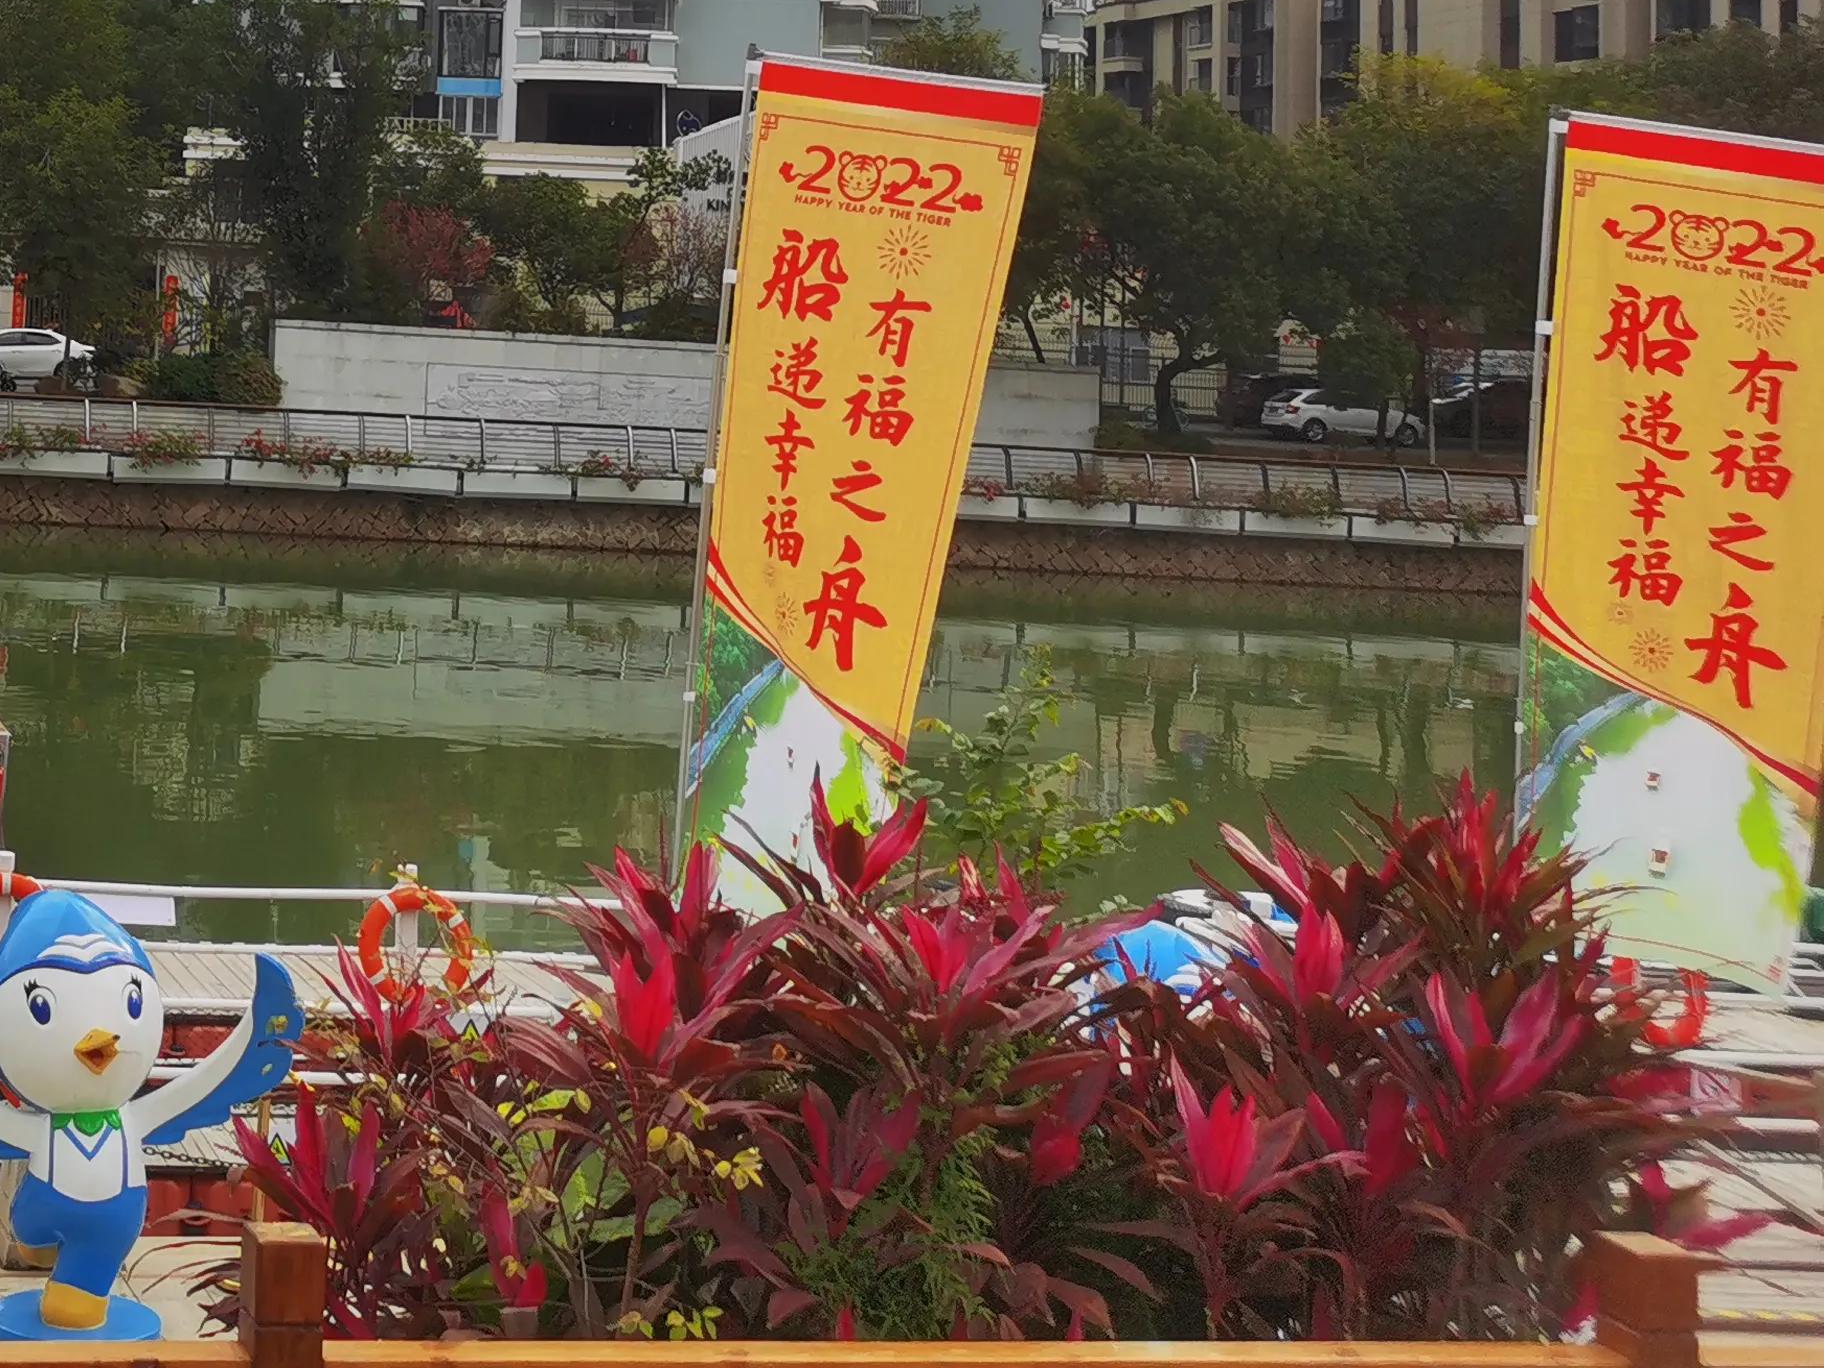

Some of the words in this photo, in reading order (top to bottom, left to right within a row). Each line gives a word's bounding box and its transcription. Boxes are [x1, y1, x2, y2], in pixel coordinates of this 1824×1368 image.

[794, 194, 833, 209] HAPPY
[838, 200, 866, 216] YEAR
[869, 205, 883, 217] OF
[889, 208, 912, 221] THE
[916, 212, 952, 228] TIGER
[796, 144, 962, 214] 2022
[1625, 251, 1668, 267] HAPPY
[1673, 259, 1708, 273] YEAR
[1714, 266, 1733, 277] OF
[1738, 269, 1764, 282] THE
[1770, 274, 1809, 290] TIGER
[1626, 203, 1816, 277] 2022
[757, 228, 849, 568] 船递幸福
[803, 288, 932, 672] 有福之舟
[1594, 283, 1699, 606] 船递幸福
[1684, 348, 1798, 709] 有福之舟
